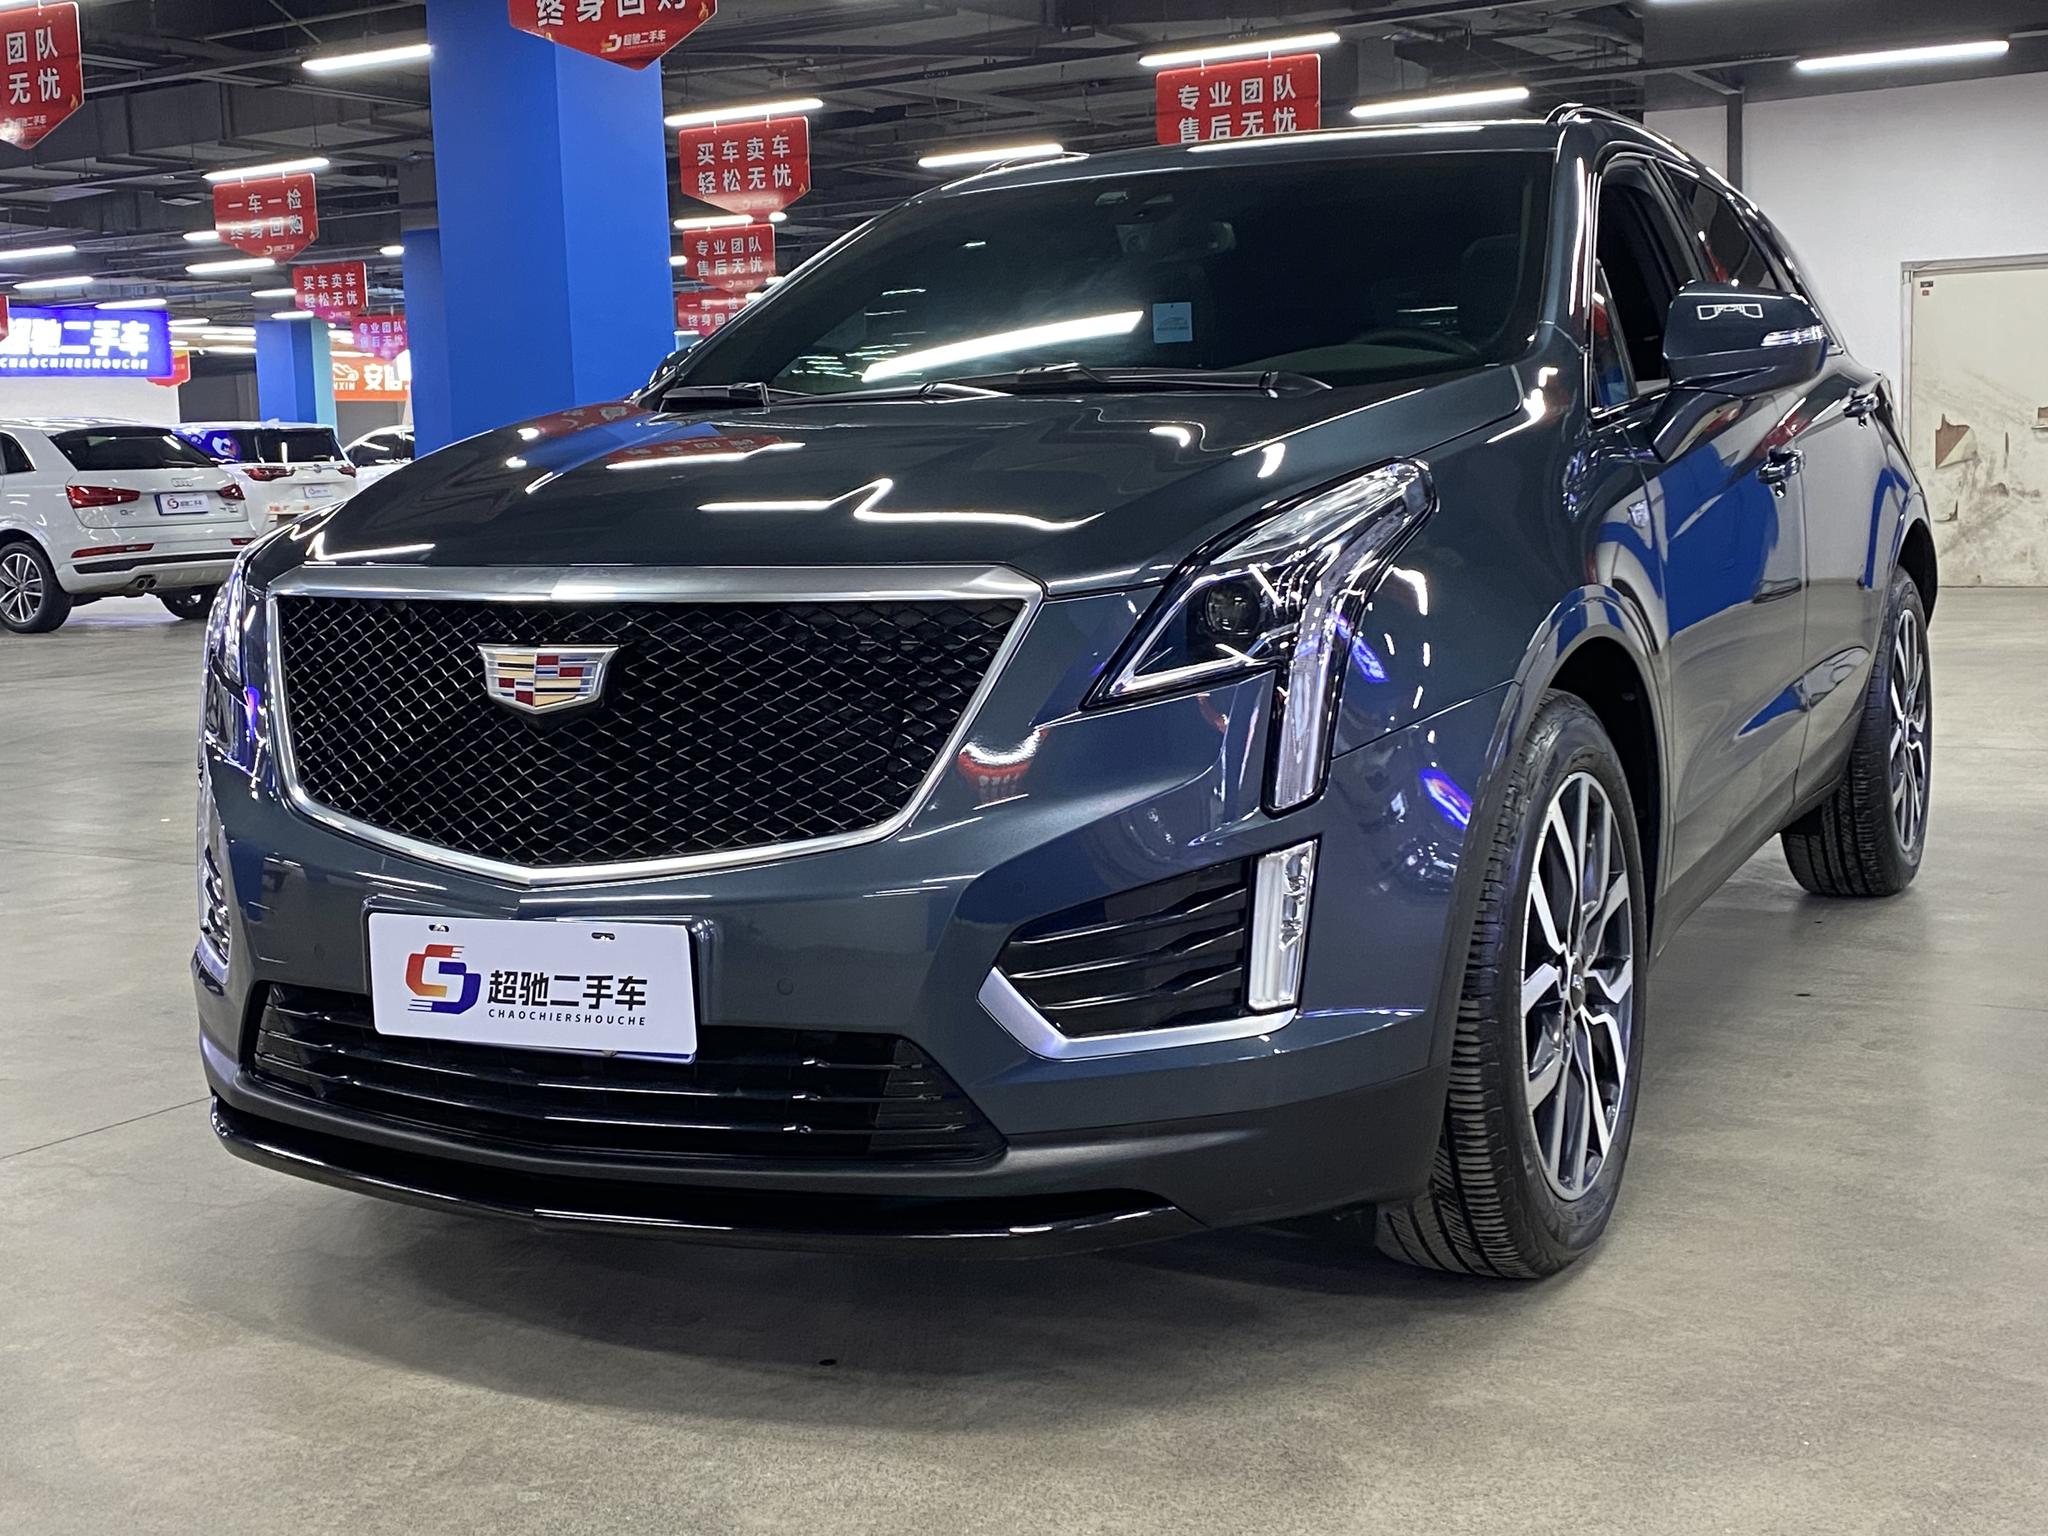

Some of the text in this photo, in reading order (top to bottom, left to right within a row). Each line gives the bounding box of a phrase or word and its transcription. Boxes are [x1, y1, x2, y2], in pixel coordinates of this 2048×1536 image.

[6, 26, 58, 65] 团队
[8, 67, 61, 105] 无忧
[1178, 73, 1297, 111] 专业团队
[1178, 106, 1297, 144] 售后无忧
[697, 134, 791, 167] 买车卖车
[697, 163, 792, 195] 轻松无忧
[227, 188, 302, 213] 一车一检
[230, 214, 304, 240] 终身回购
[695, 235, 762, 257] 专业团队
[696, 256, 764, 277] 售后无忧
[303, 271, 357, 291] 买车卖车
[304, 290, 358, 308] 轻松无忧
[687, 297, 739, 312] 一车检
[487, 970, 647, 1011] 超驰二手车
[488, 1008, 646, 1026] CHAOCHIERSHOUCHE
